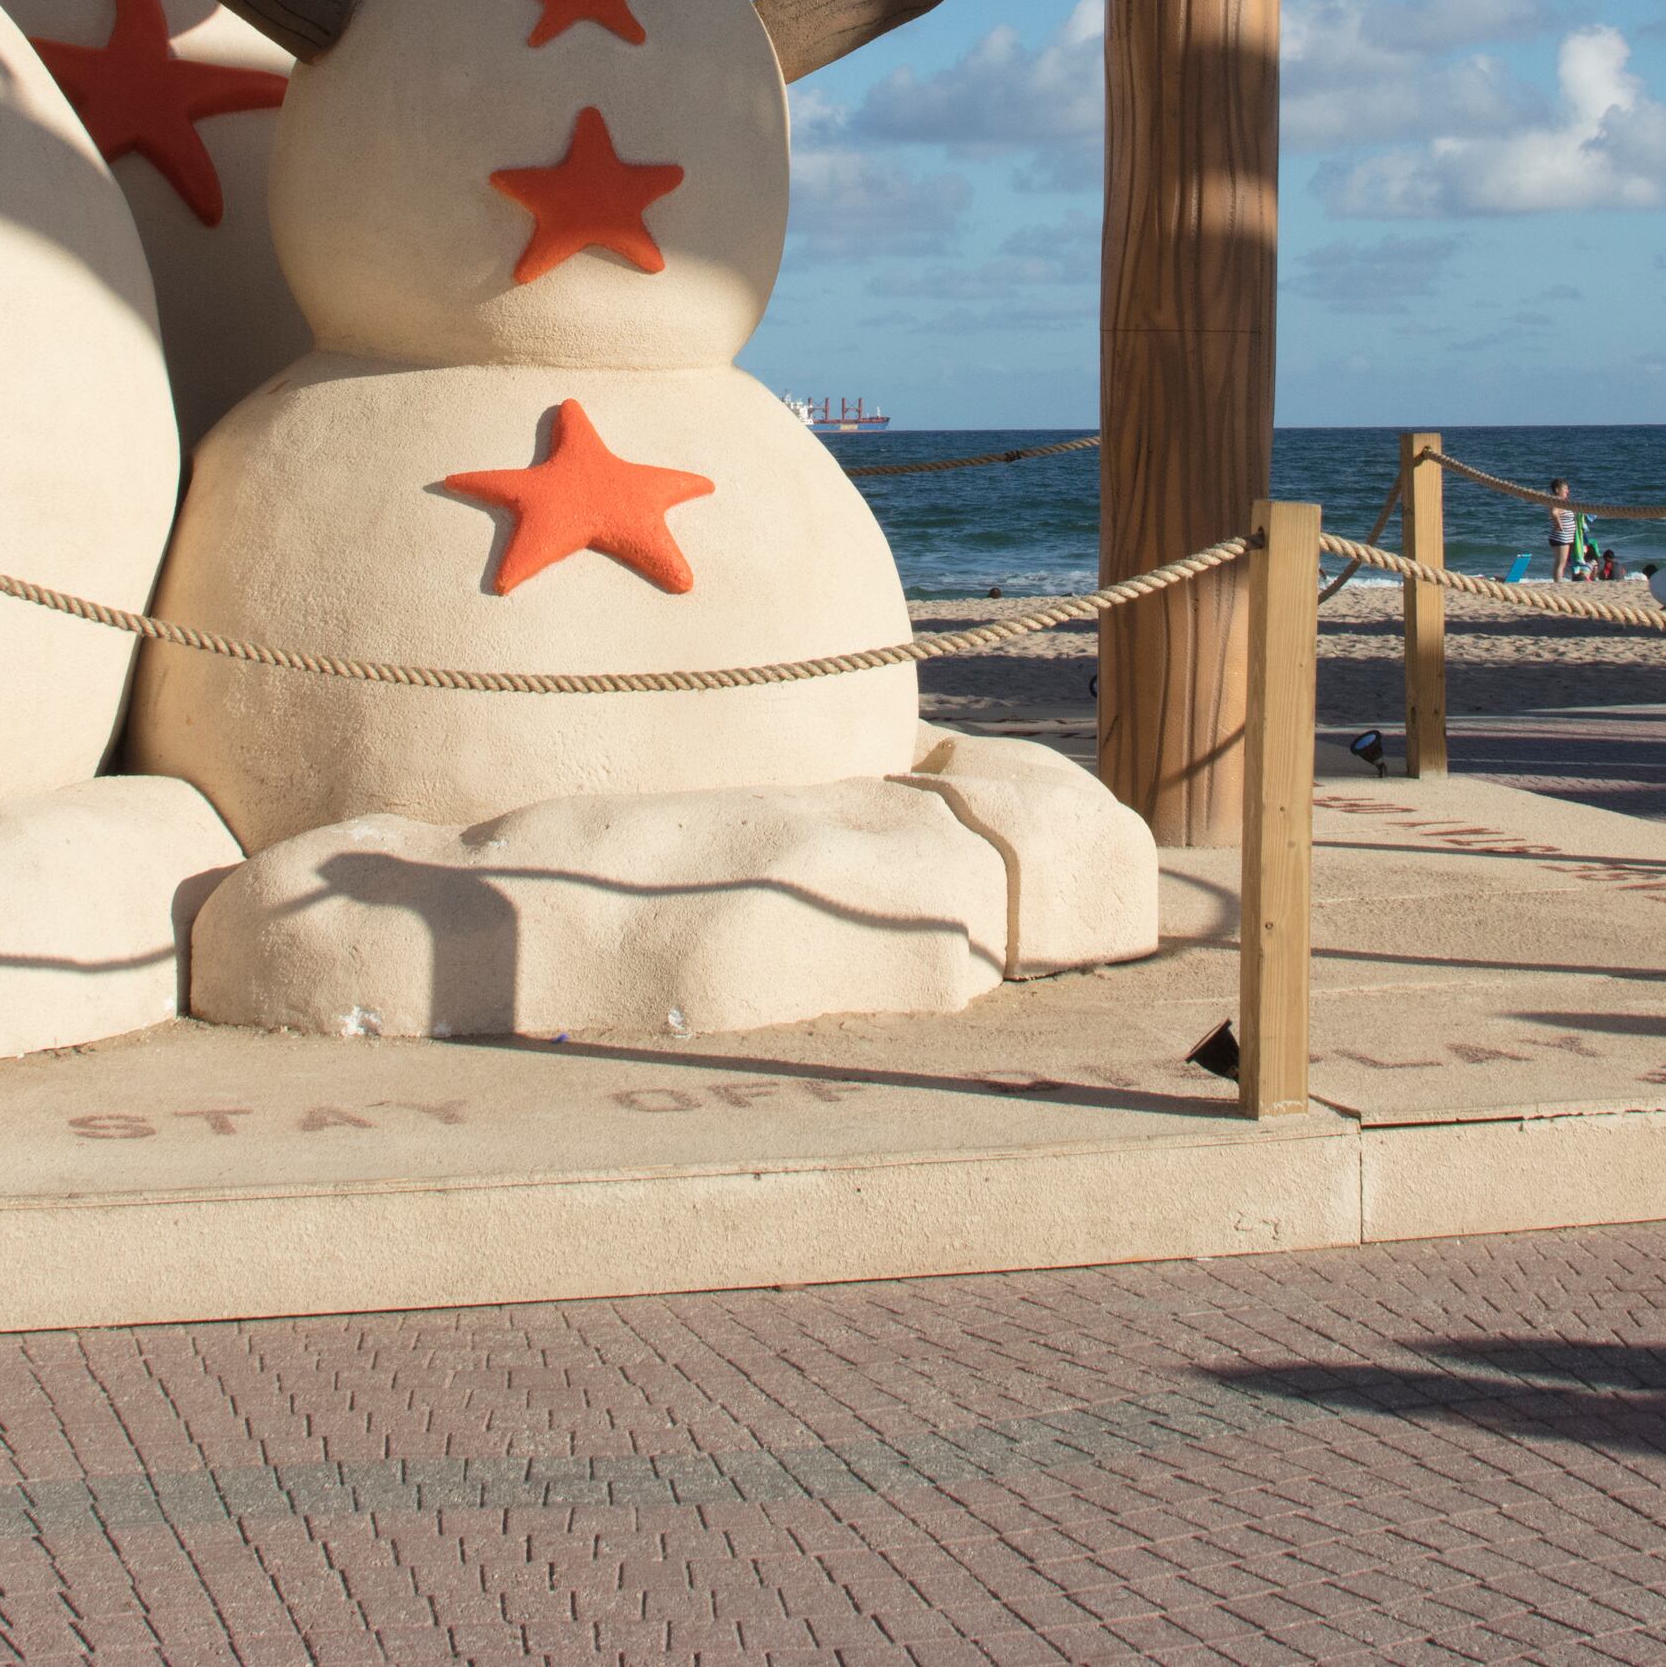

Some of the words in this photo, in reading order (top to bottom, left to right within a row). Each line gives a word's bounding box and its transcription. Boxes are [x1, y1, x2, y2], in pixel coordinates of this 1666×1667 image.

[1384, 819, 1561, 854] STAY
[67, 1098, 467, 1141] STAY
[610, 1077, 870, 1115] OFF
[962, 1034, 1601, 1094] DILAY
